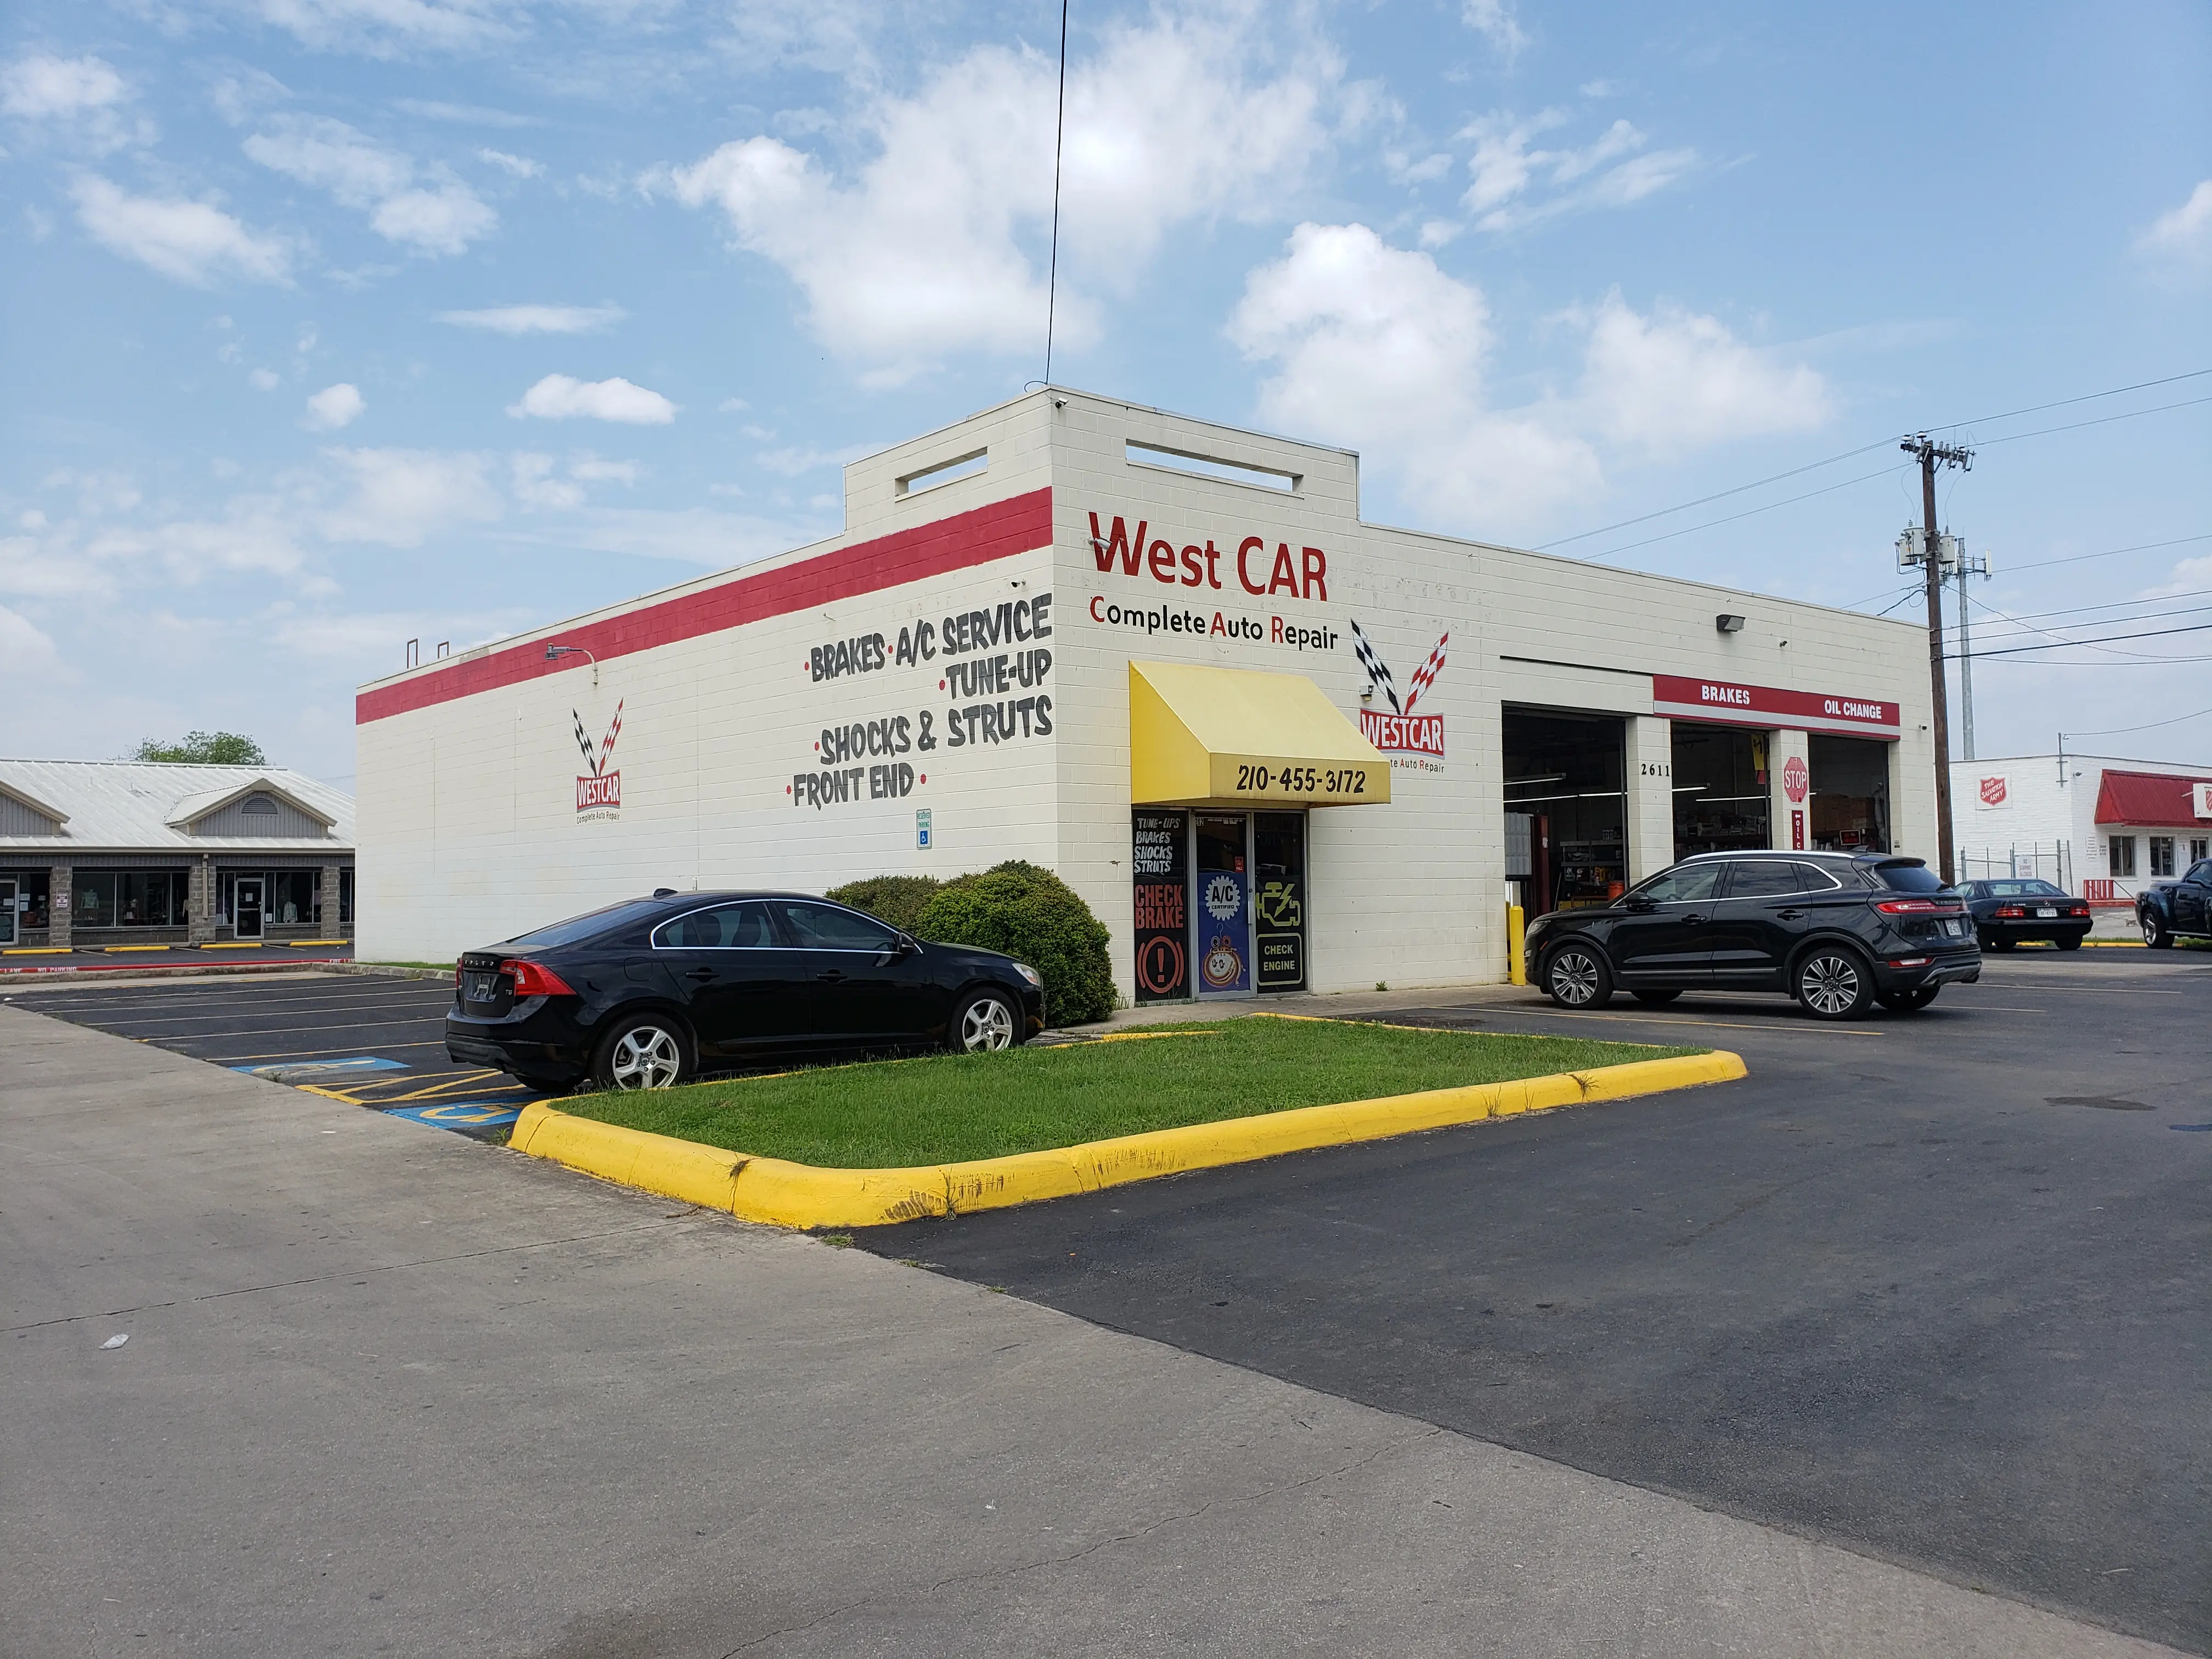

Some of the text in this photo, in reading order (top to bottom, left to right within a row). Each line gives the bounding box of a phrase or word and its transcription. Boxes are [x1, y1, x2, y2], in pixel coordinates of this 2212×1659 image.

[1088, 512, 1222, 590] West
[1237, 536, 1328, 601] CAR
[1090, 596, 1338, 650] Complete Auto Repair
[811, 593, 1052, 682] BRAKES A/C SERVICE
[946, 648, 1052, 699] TUNE-UP
[1702, 685, 1750, 705] BRAKES
[1824, 699, 1882, 719] OIL CHANGE
[820, 695, 1052, 765] SHOCKS & STRUTS
[1362, 714, 1443, 752] WESTCAR
[1400, 758, 1417, 769] Auto
[1420, 760, 1444, 774] Repair
[1641, 763, 1670, 777] 2611
[794, 762, 915, 810] FRONT END
[1237, 765, 1365, 793] 210-455-3172
[1785, 770, 1807, 789] STOP
[1984, 780, 1994, 789] THE
[578, 776, 620, 806] WESTCAR
[1982, 781, 2003, 799] SALVATION
[1990, 789, 2003, 803] ARMY
[577, 812, 595, 824] Complete
[606, 811, 620, 821] Repair
[1137, 817, 1180, 829] TUNE-UPS
[1136, 831, 1171, 844] BRAKES
[1134, 845, 1173, 860] SHOCKS
[1134, 860, 1171, 873] STRUTS
[1135, 884, 1183, 907] CHECK
[1212, 885, 1233, 904] A/C
[1136, 907, 1183, 929] BRAKE
[1264, 944, 1294, 955] CHECK
[1263, 960, 1295, 971] ENGINE
